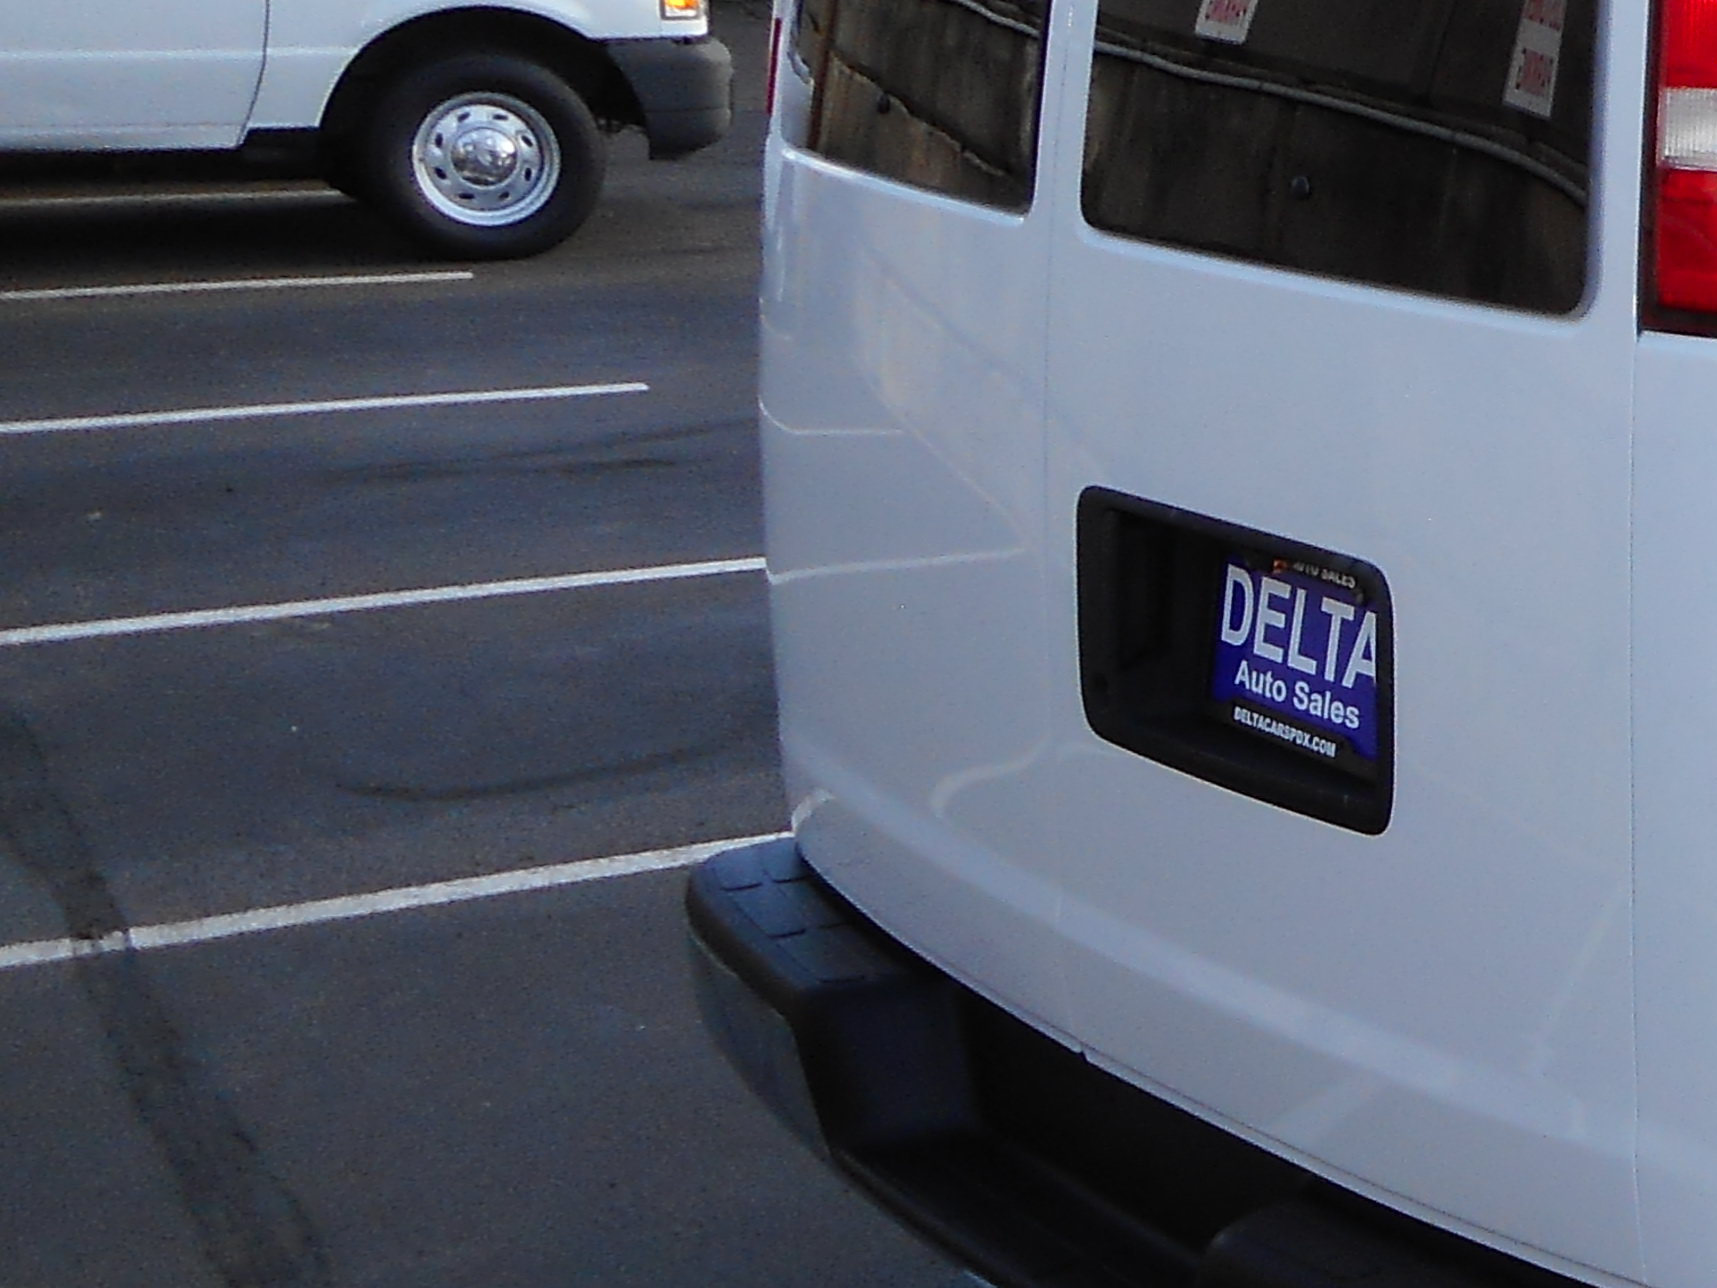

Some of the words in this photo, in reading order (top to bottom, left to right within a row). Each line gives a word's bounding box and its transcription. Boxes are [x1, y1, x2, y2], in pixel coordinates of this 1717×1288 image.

[1220, 562, 1378, 689] DELTA
[1234, 660, 1287, 703] Auto
[1292, 680, 1361, 730] Sales
[1233, 705, 1337, 759] DELTACARSPDX.COM
